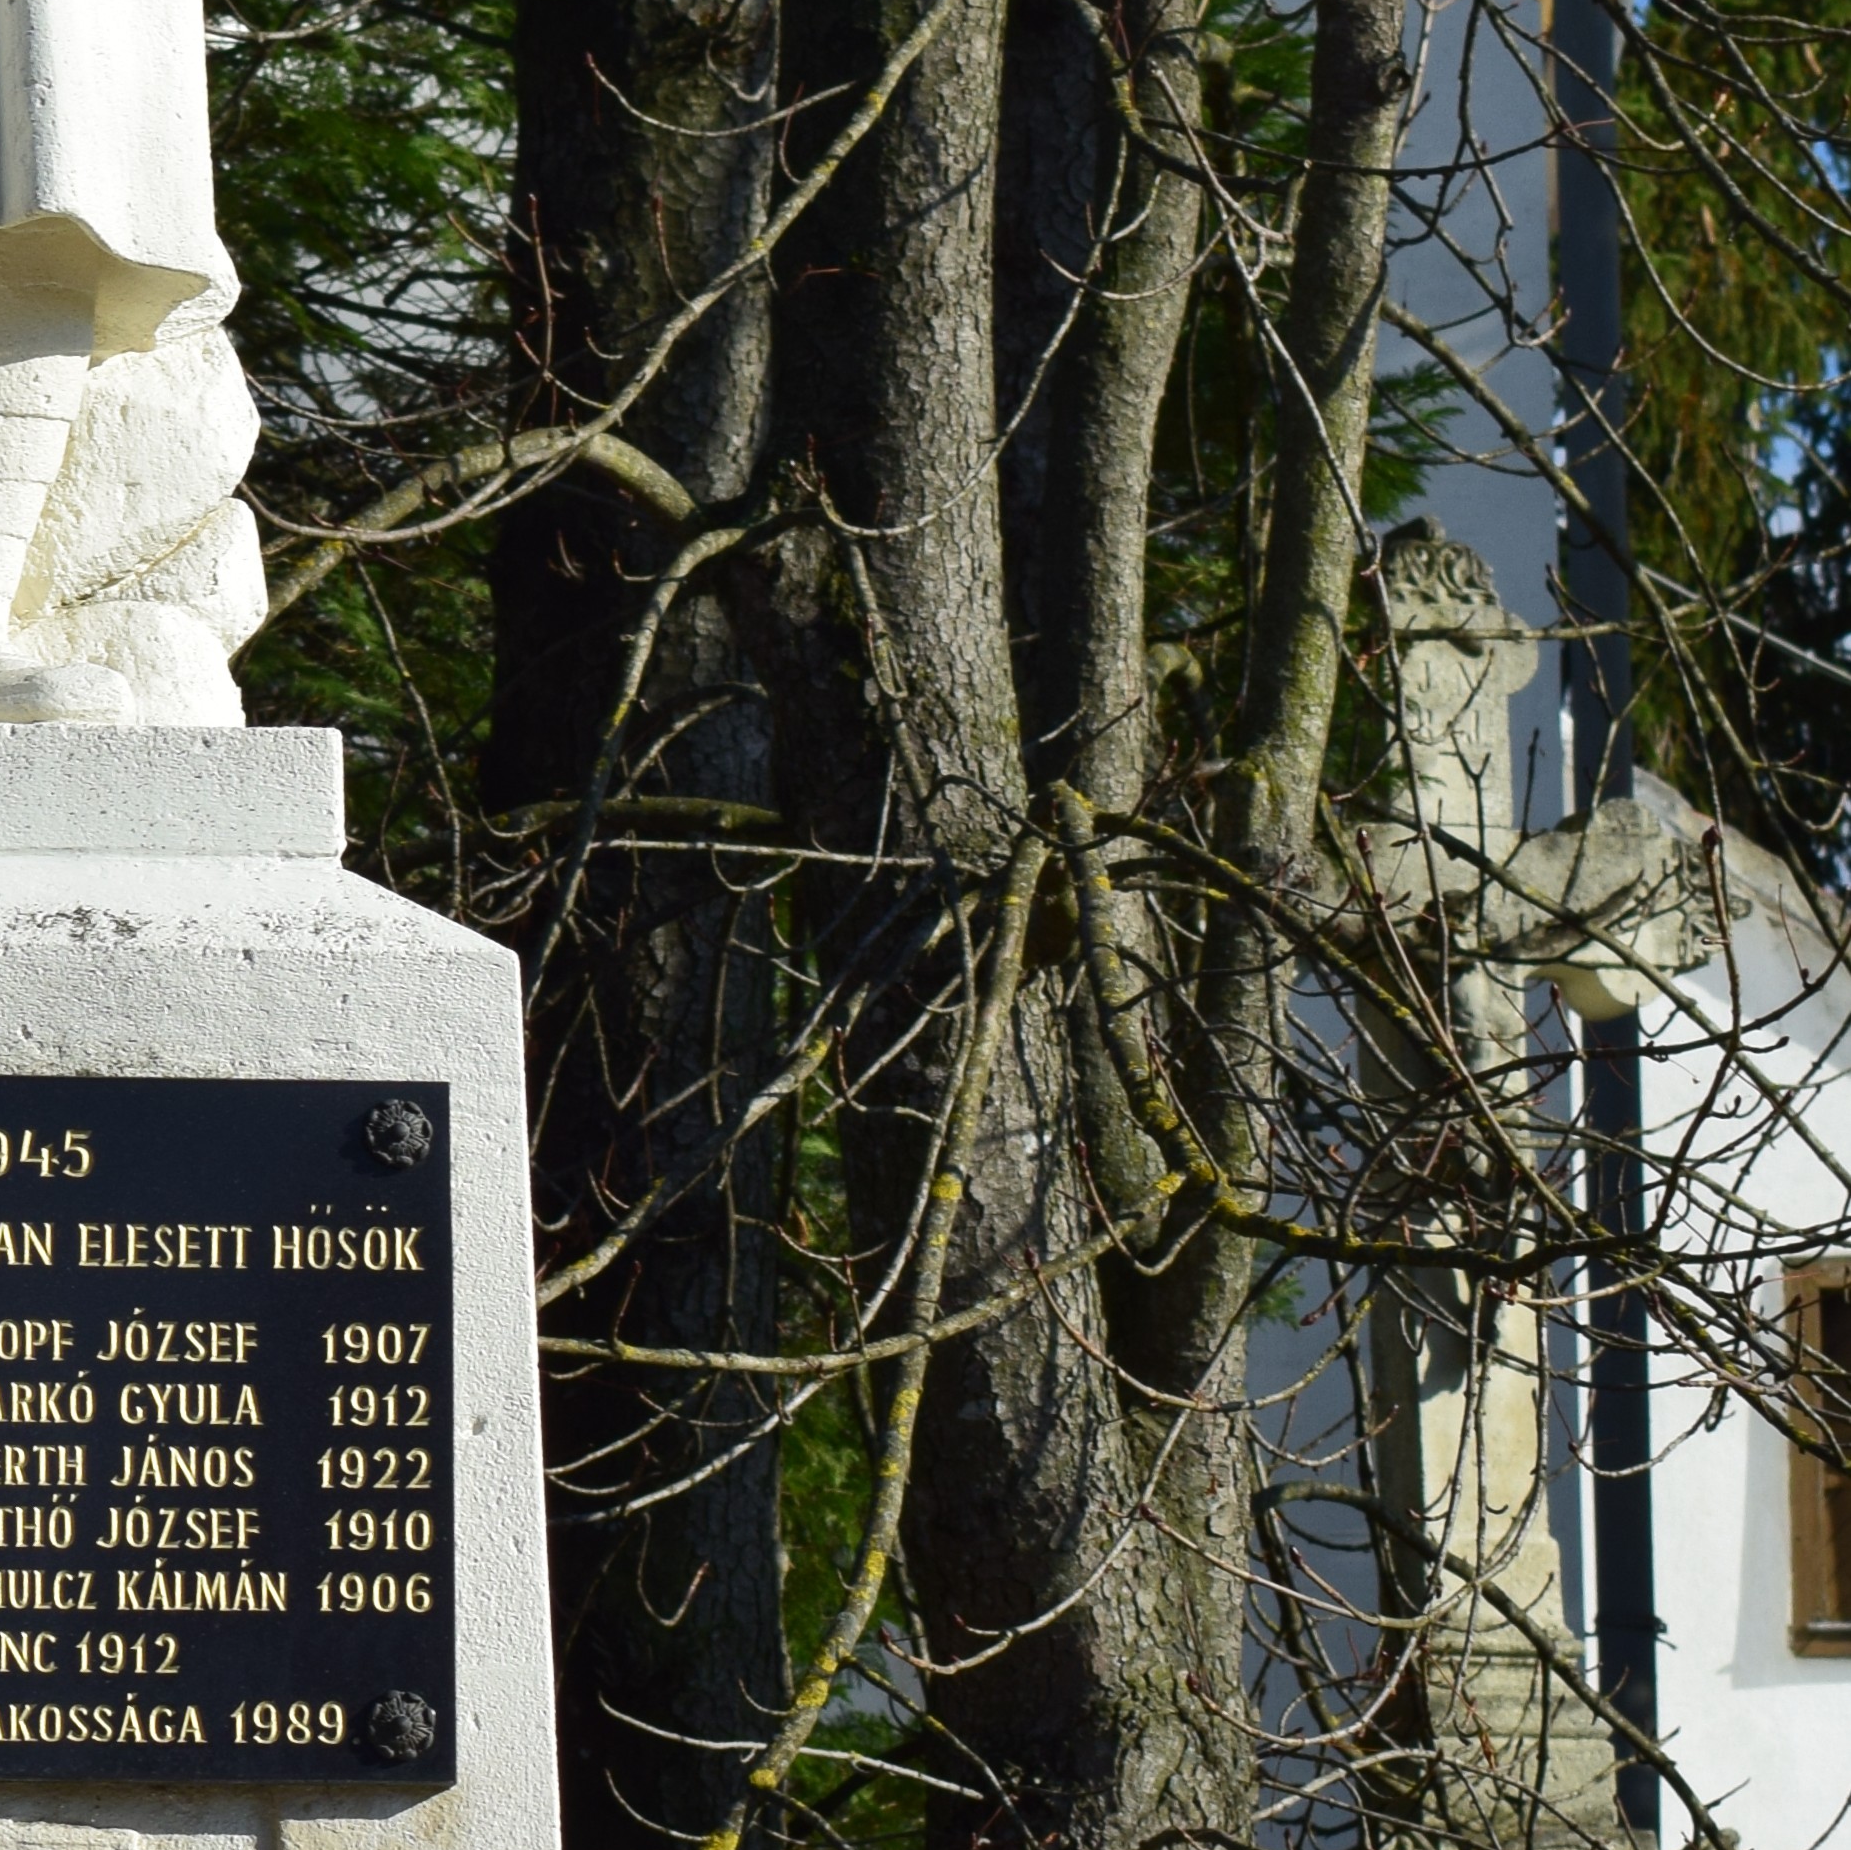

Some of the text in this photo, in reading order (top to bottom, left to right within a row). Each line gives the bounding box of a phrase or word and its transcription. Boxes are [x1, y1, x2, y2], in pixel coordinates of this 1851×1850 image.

[79, 1222, 253, 1269] ELESETT
[273, 1204, 426, 1271] HŐSÖK
[97, 1308, 259, 1364] JÓZSEF
[321, 1323, 433, 1365] 1907
[120, 1383, 264, 1426] GYULA
[327, 1385, 432, 1427] 1912
[110, 1433, 257, 1488] JÁNOS
[317, 1447, 433, 1490] 1922
[96, 1495, 261, 1549] JÓZSEF
[324, 1508, 434, 1551] 1910
[117, 1558, 288, 1612] KÁLMÁN
[316, 1571, 434, 1613] 1906
[76, 1634, 181, 1676] 1912
[228, 1701, 346, 1746] 1989
